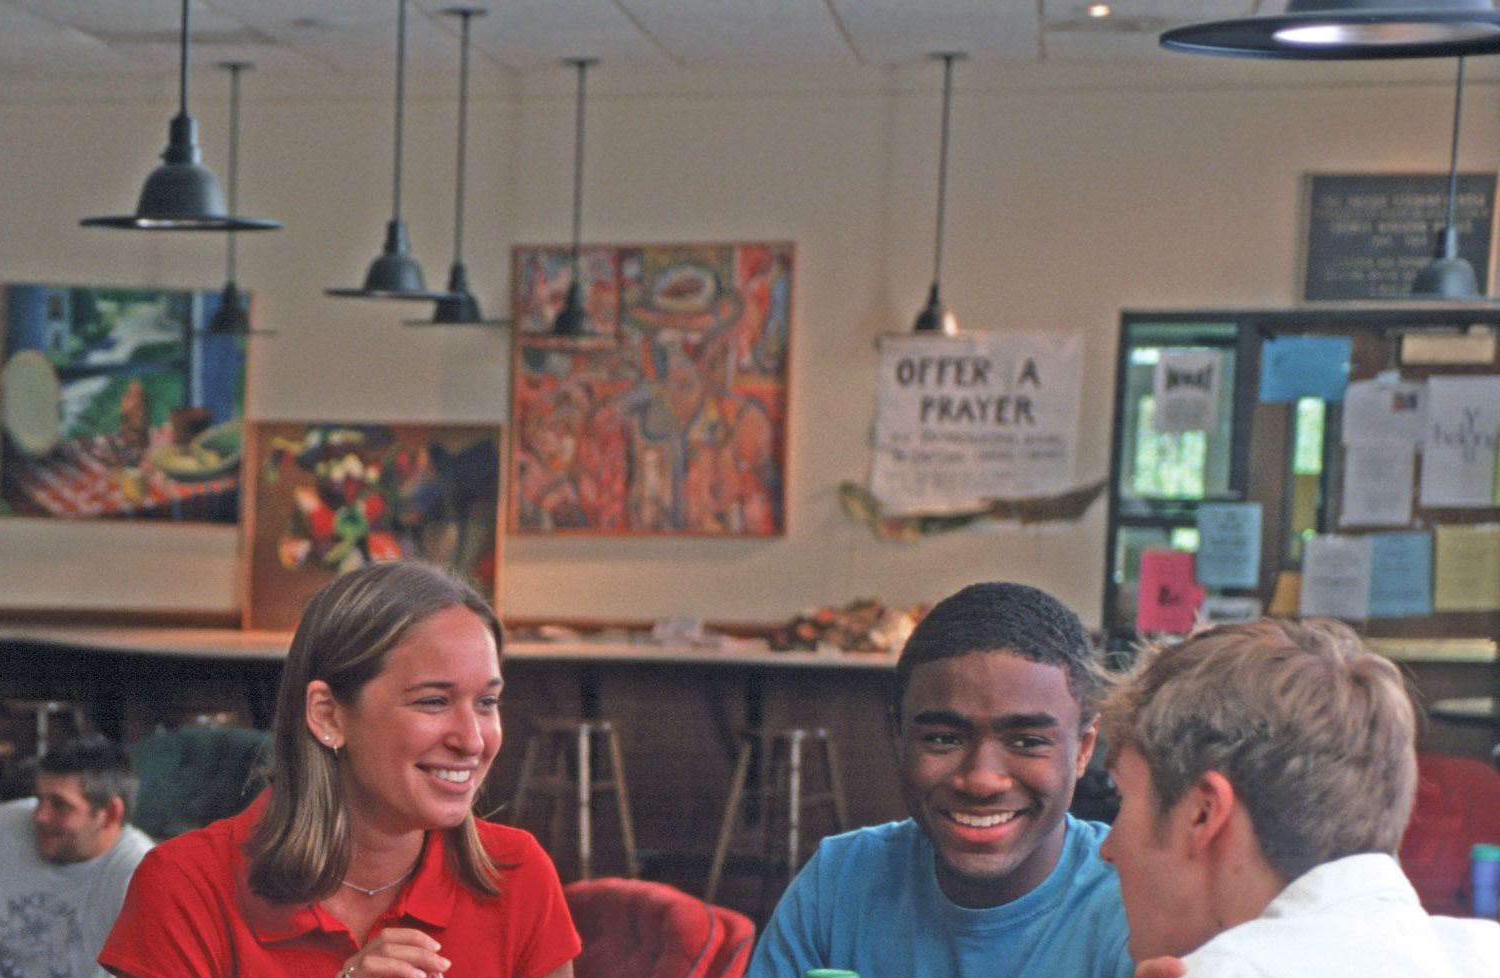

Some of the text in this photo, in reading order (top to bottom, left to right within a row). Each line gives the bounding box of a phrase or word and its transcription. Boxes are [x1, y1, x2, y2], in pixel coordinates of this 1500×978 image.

[896, 357, 1041, 387] OFFER A
[919, 396, 1035, 425] PRAYER
